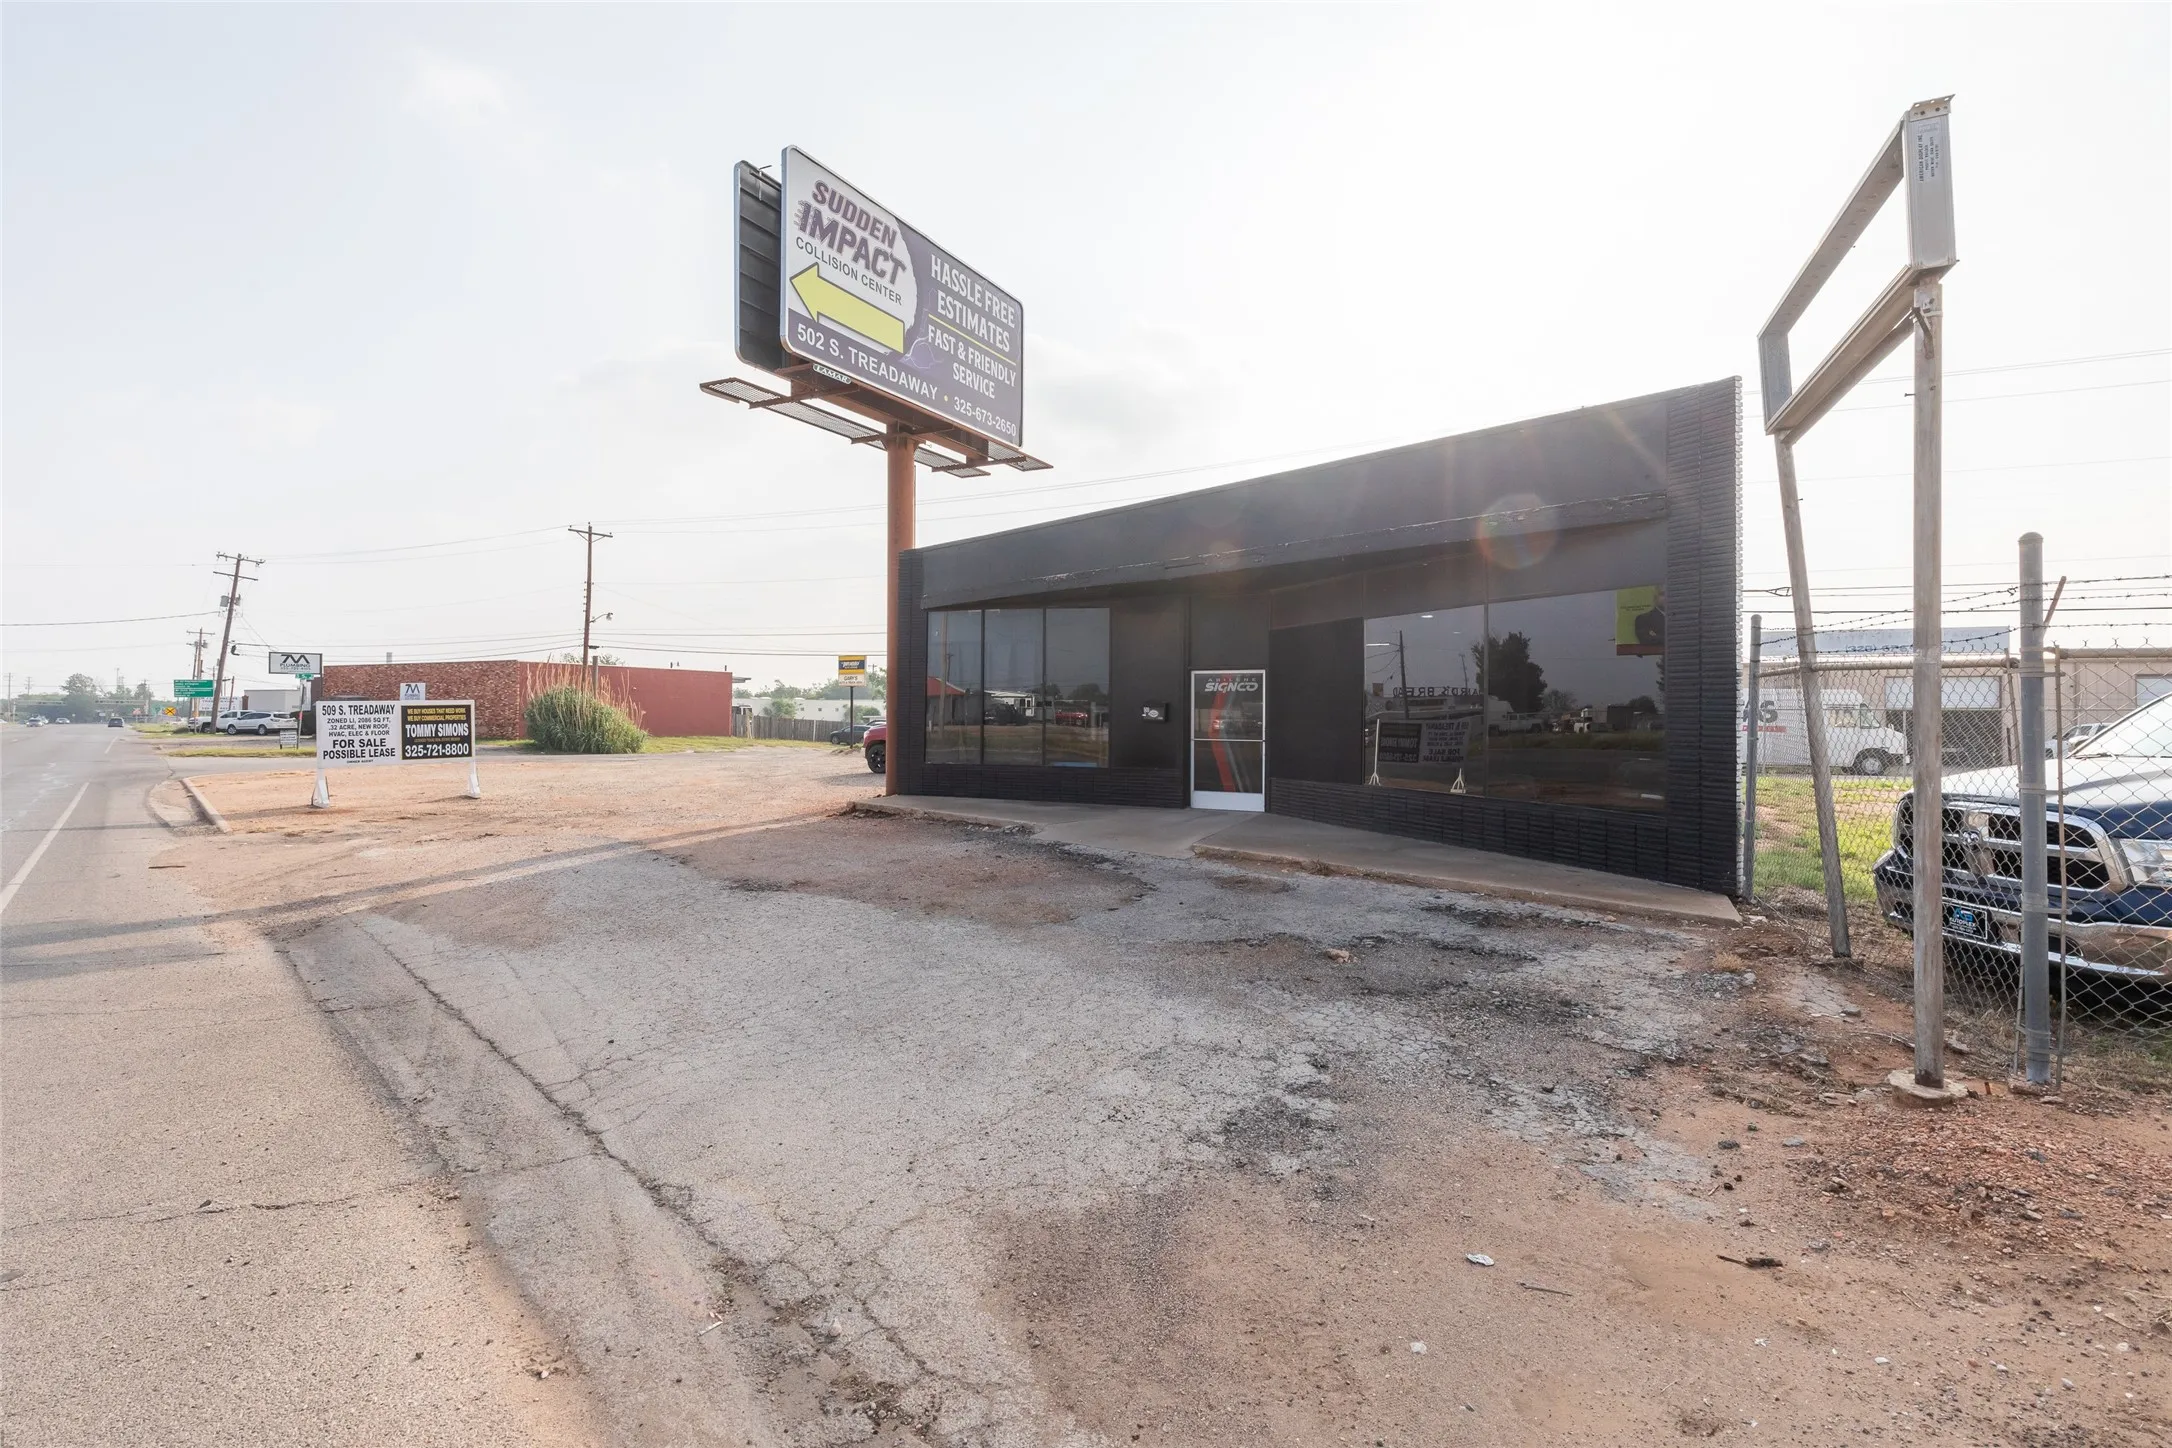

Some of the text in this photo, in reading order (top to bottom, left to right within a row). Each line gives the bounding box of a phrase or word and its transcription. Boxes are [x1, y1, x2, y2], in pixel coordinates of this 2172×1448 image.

[812, 180, 898, 249] SUDDEN
[796, 200, 907, 285] IMPACT
[796, 236, 902, 305] COLLISION CENTER
[932, 254, 1015, 328] HASSLE FREE
[938, 290, 1010, 352] ESTIMATES
[815, 365, 848, 383] LAMAR
[928, 324, 1016, 387] FAST & FRIENDLY
[798, 323, 1016, 436] 502 S. TREADAWAY 325-673-2650
[952, 362, 995, 399] SERVICE
[1205, 682, 1258, 693] SIGNCO
[322, 704, 395, 715] 509 S. TREADAWAY
[333, 738, 387, 748] FOR SALE
[405, 723, 468, 737] TOMMY SIMONS
[323, 748, 396, 759] POSSIBLE LEASE
[405, 743, 469, 757] 325-721-8800
